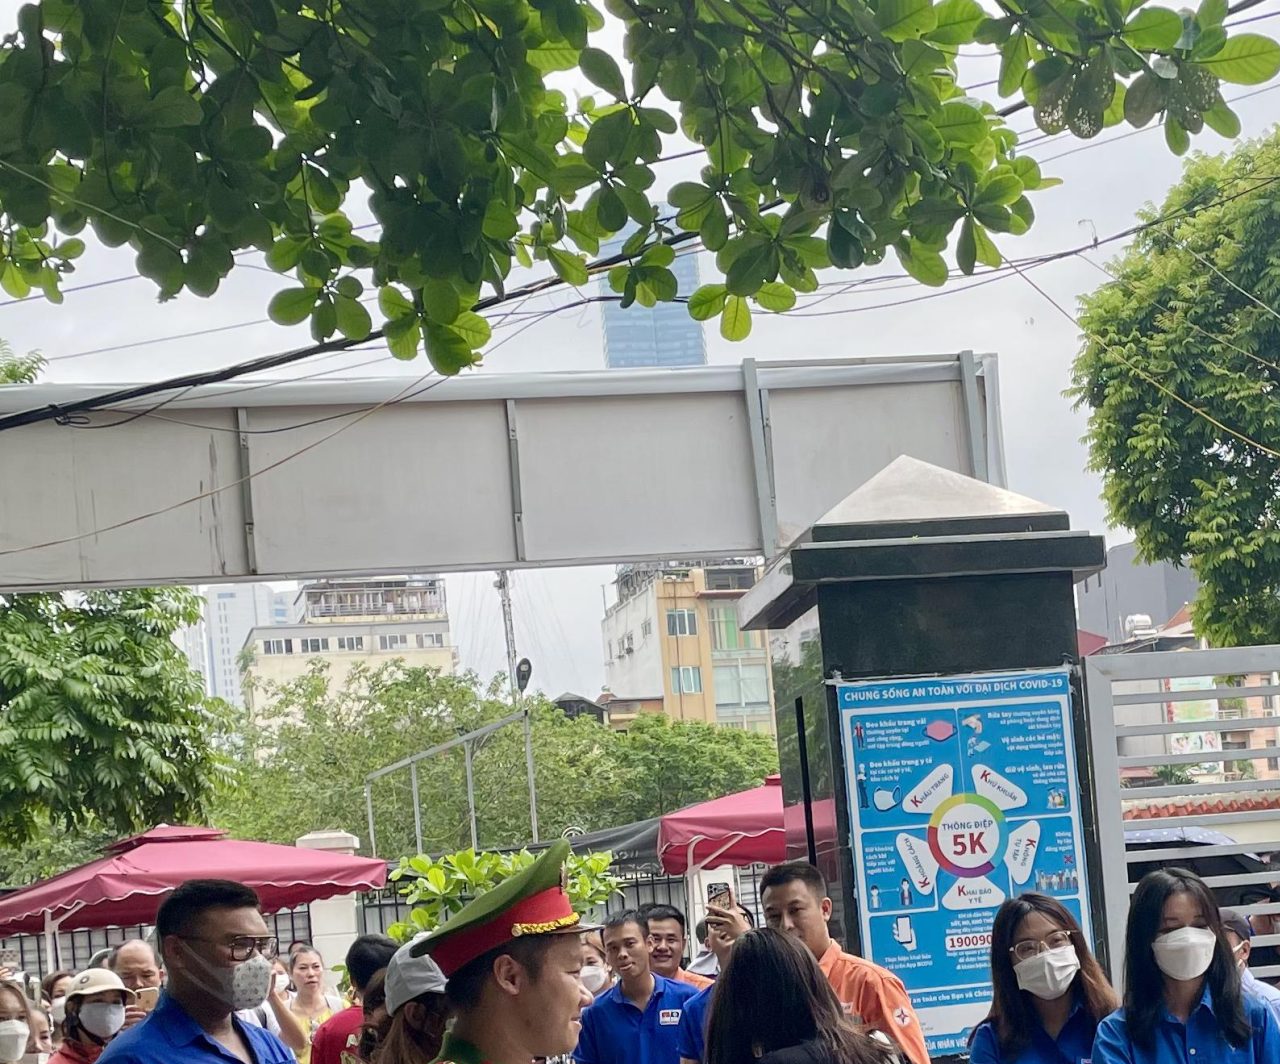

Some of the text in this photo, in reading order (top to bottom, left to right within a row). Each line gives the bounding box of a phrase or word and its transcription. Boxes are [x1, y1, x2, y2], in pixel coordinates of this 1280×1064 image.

[844, 679, 1063, 701] CHUNG SỐNG AN TOÀN VỚI ĐẠI DỊCH COVID-19
[910, 773, 950, 807] KHẨU TRANG
[980, 770, 1018, 801] KHỬ KHUẨN
[942, 819, 993, 831] THÔNG ĐIỆP
[953, 832, 988, 856] 5K
[958, 885, 978, 896] KHAI
